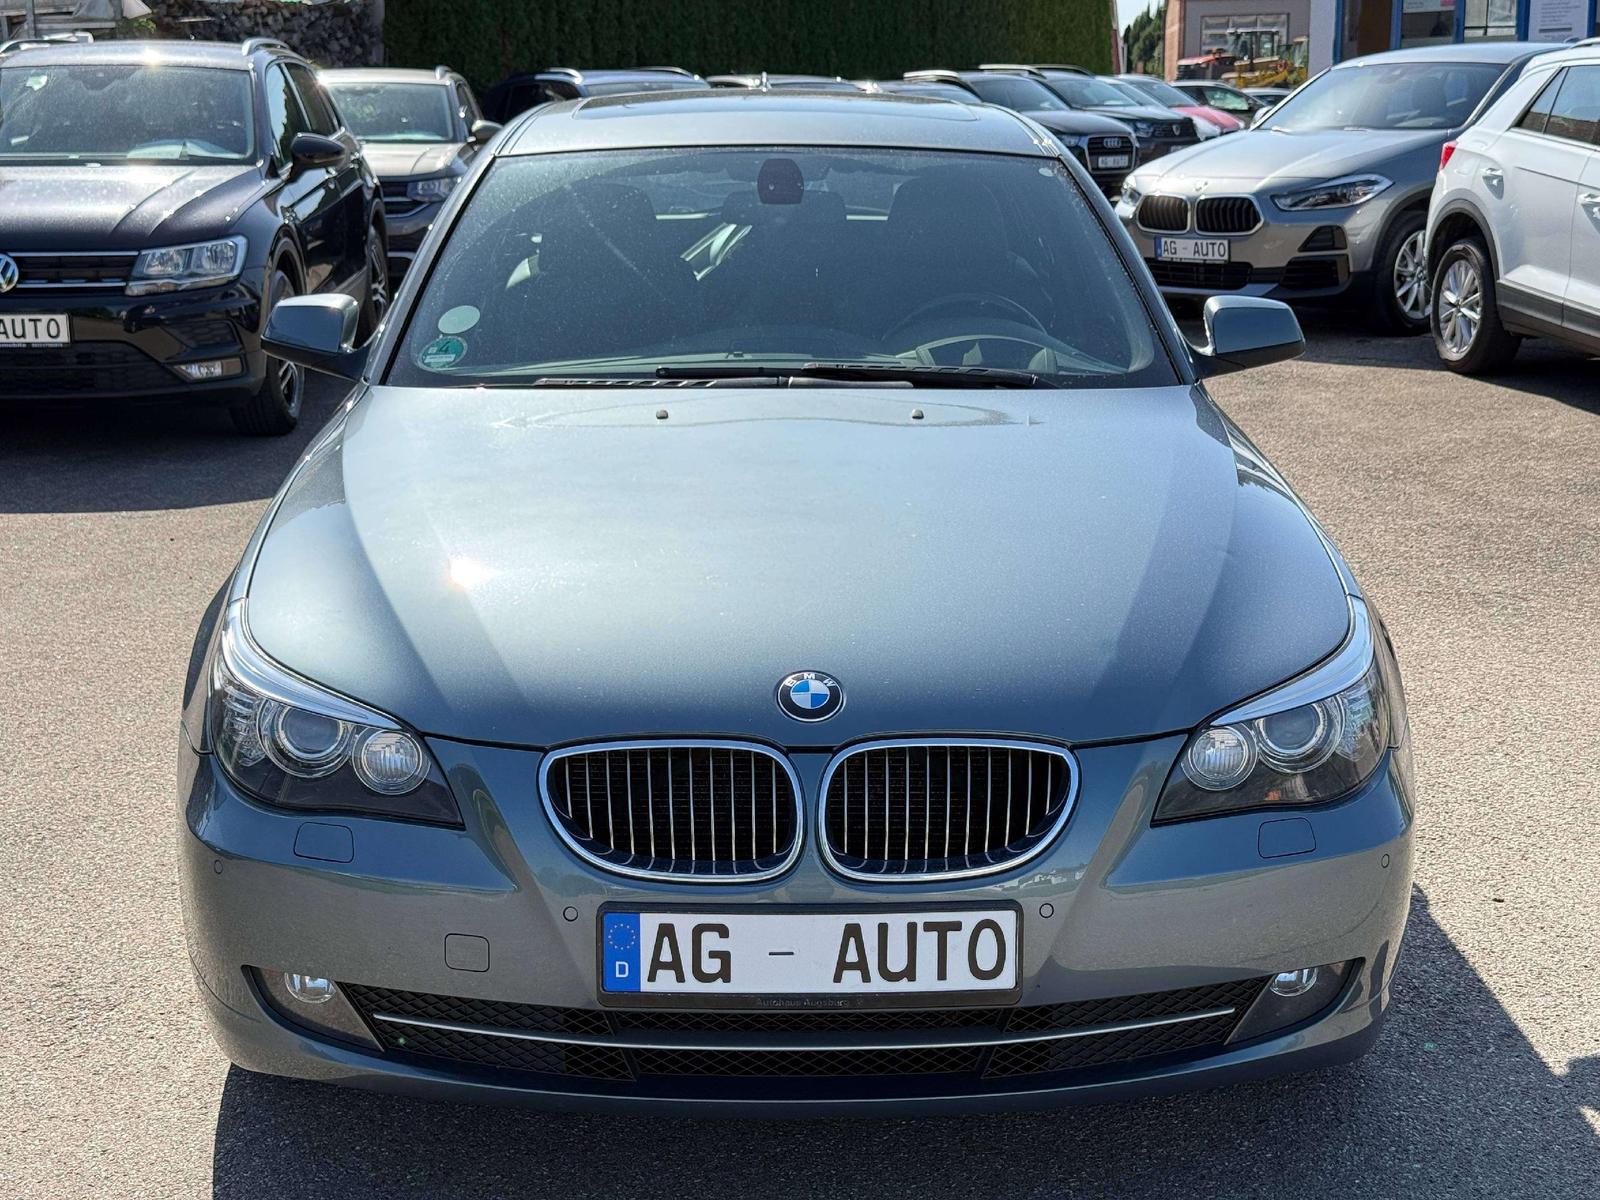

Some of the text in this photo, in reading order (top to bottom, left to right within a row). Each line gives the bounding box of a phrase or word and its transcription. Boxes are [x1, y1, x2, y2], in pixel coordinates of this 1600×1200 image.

[1163, 240, 1177, 255] AG
[1193, 241, 1226, 257] AUTO
[0, 318, 61, 339] AUTO
[784, 673, 836, 687] BMW
[646, 922, 732, 984] AG
[833, 919, 1007, 984] AUTO
[615, 961, 629, 978] D
